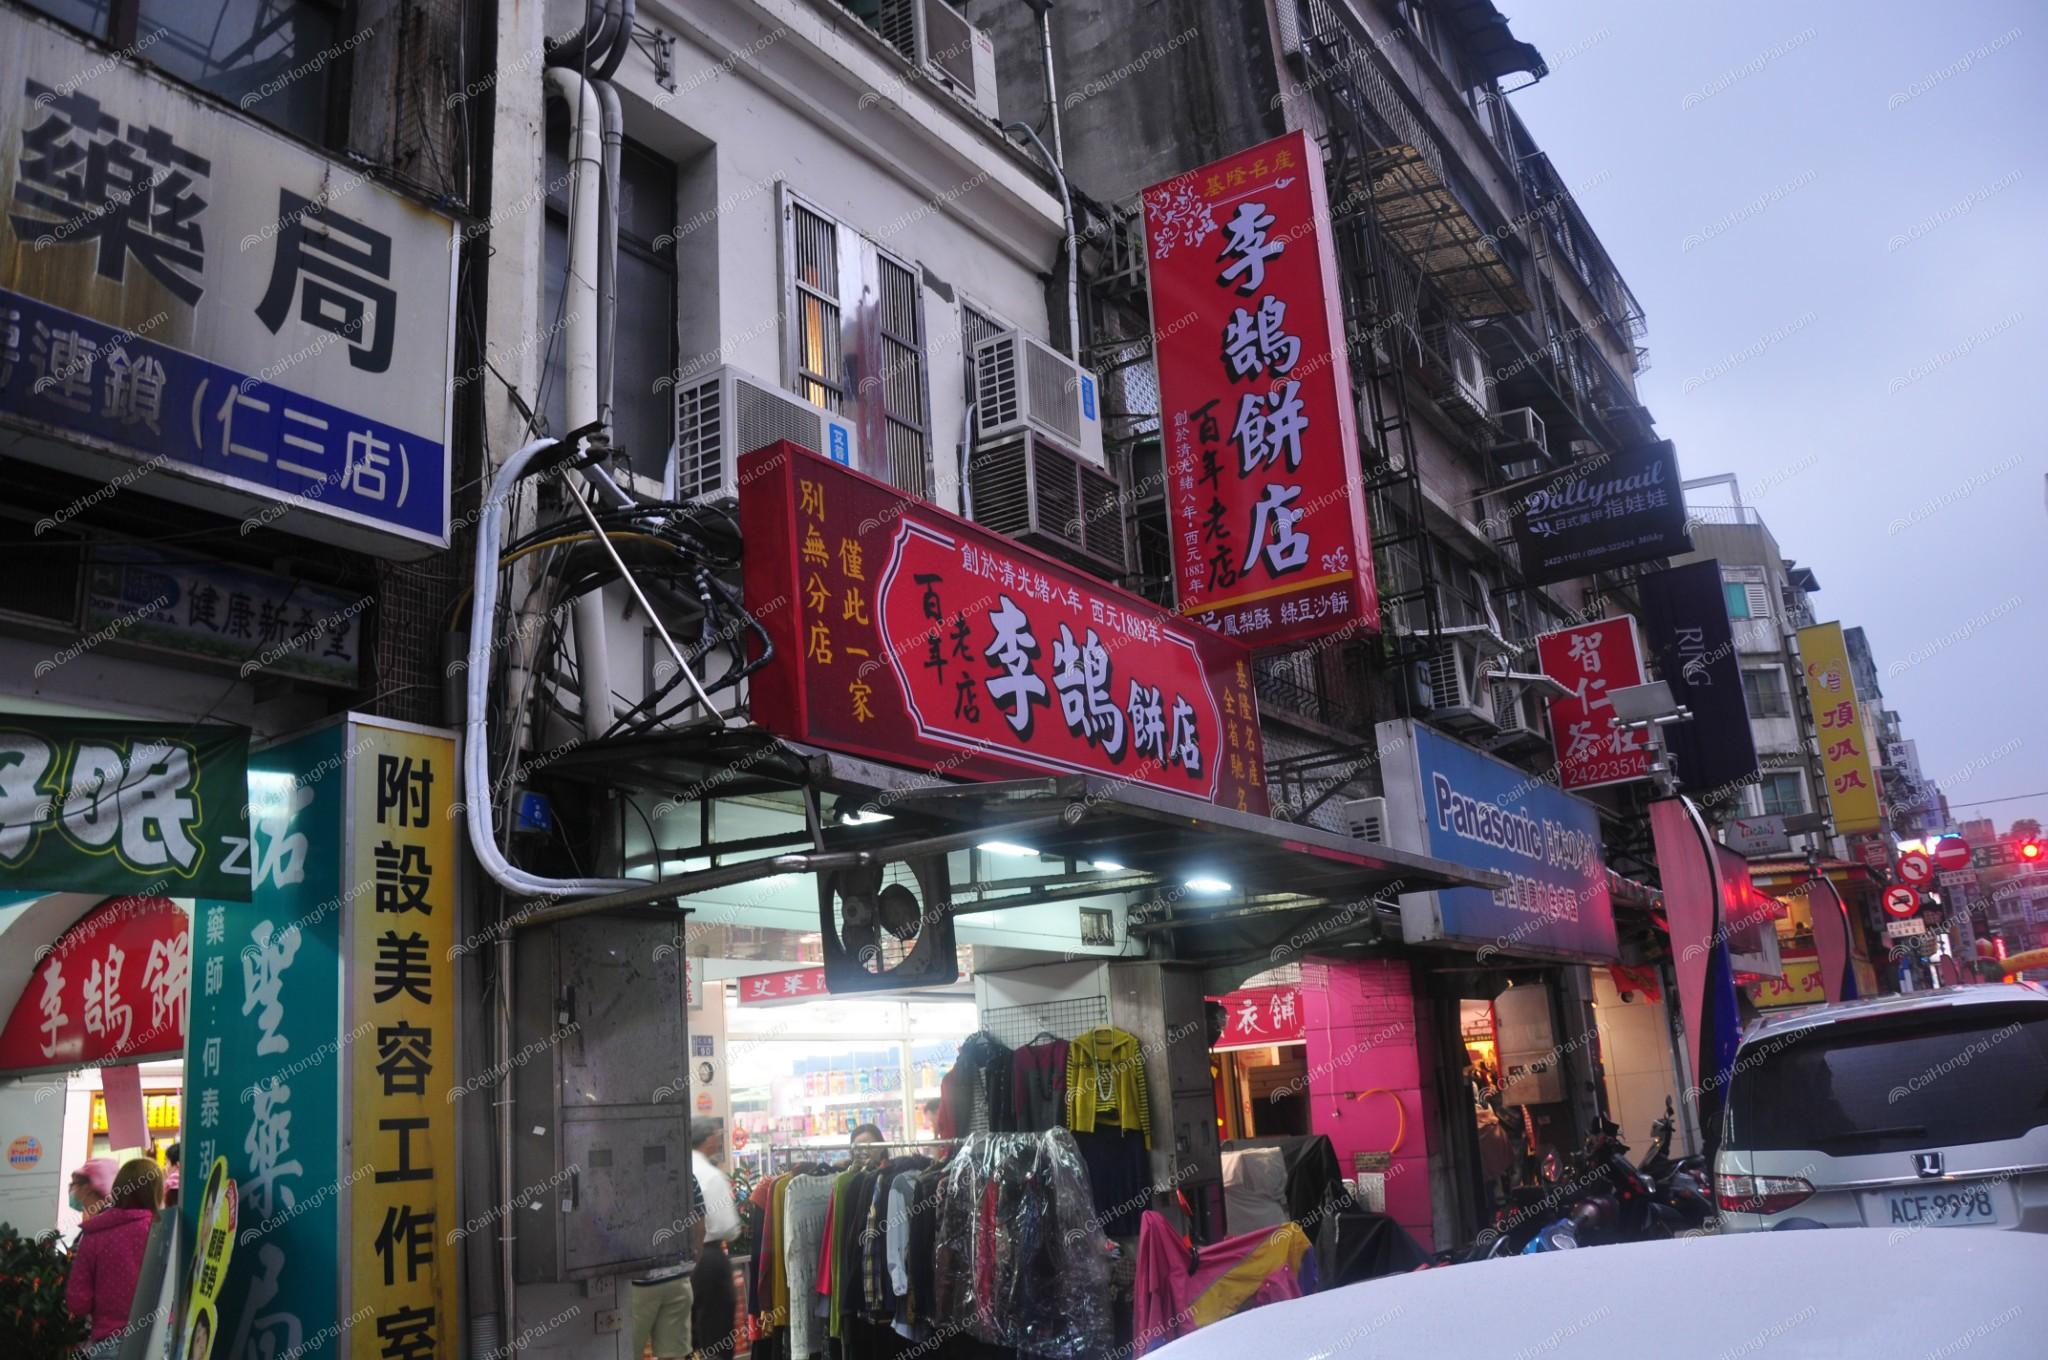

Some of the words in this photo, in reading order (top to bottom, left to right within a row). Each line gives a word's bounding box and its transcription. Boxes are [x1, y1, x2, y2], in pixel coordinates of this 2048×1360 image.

[1202, 148, 1296, 199] 基隆名產
[9, 76, 398, 374] 藥局
[1221, 202, 1311, 577] 李鵠餅店
[1190, 399, 1237, 593] 百年老店
[1525, 459, 1665, 517] Dollynail
[1555, 509, 1604, 531] 日式美甲
[1604, 487, 1669, 520] 指娃娃
[798, 480, 834, 667] 別無分店
[960, 544, 1084, 617] 創於清光緒八年
[1223, 607, 1273, 637] 鳳梨酥
[1281, 591, 1350, 626] 綠豆沙餅
[187, 580, 354, 662] 健康新希望
[838, 537, 876, 725] 僅此一家
[985, 596, 1201, 780] 李鵠餅店
[1568, 754, 1650, 785] 24223514
[1821, 700, 1867, 794] 頂呱呱
[1432, 771, 1543, 861] Panasonic
[372, 754, 436, 1360] 附設美容工作室
[1225, 991, 1298, 1036] 衣舖
